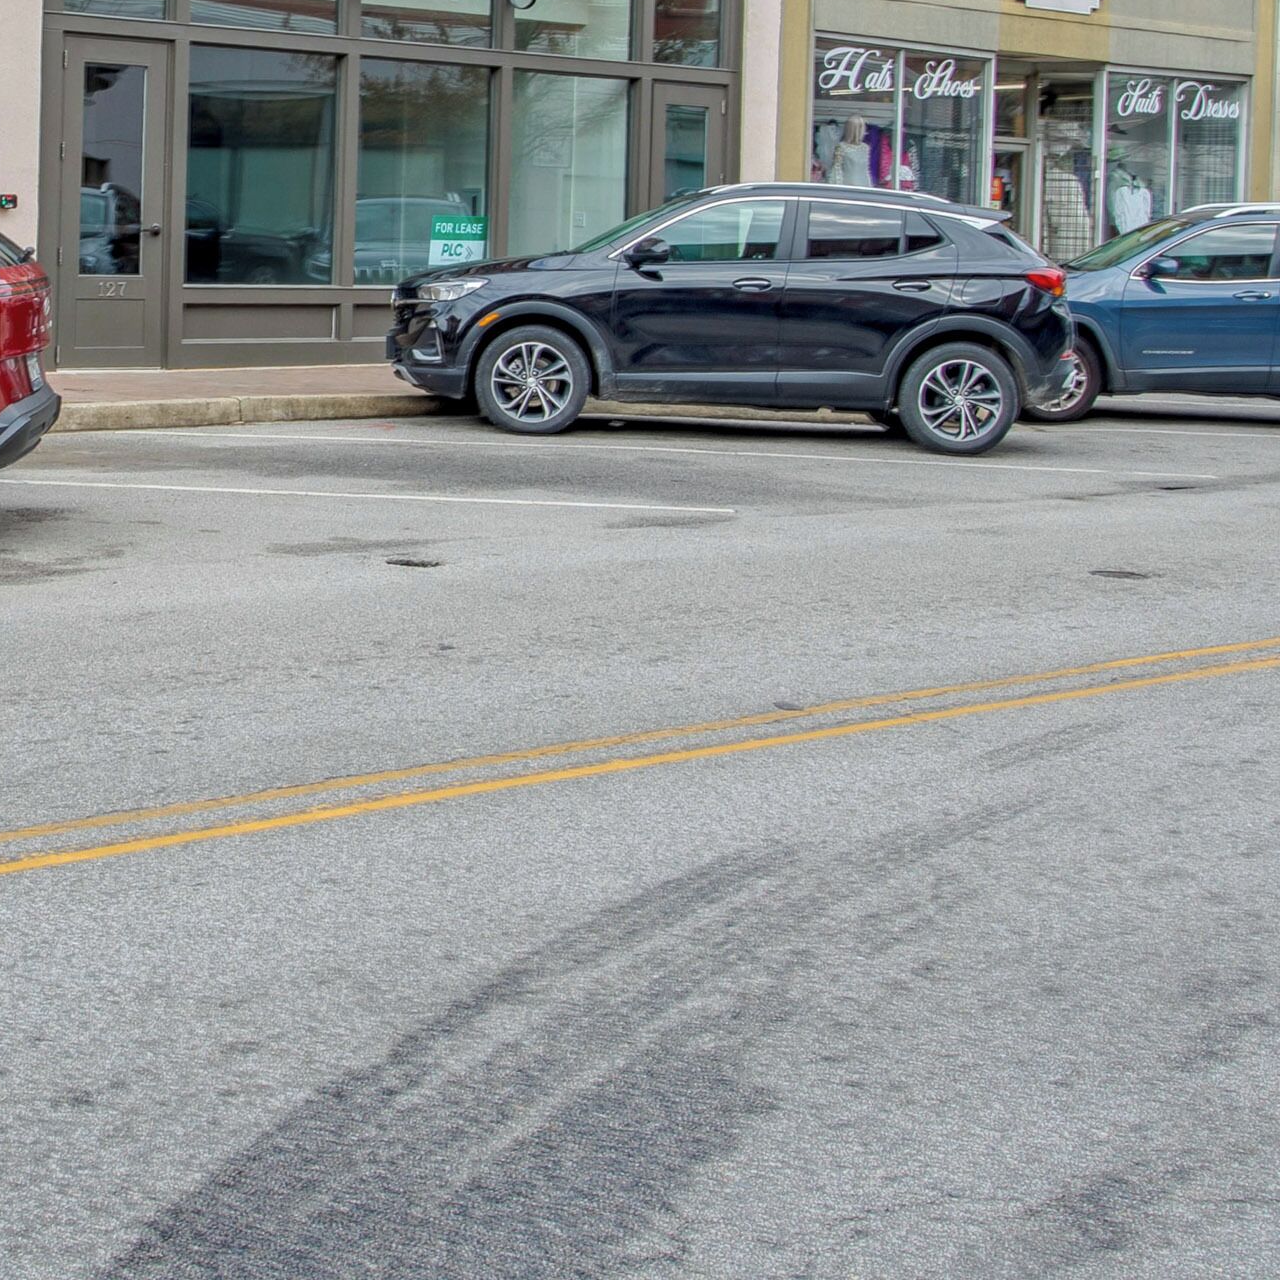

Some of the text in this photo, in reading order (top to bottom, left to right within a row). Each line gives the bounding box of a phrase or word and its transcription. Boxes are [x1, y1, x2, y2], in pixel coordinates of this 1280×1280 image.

[819, 47, 977, 100] Hats Shoes
[1118, 79, 1240, 120] Suits Dresses
[435, 222, 484, 234] FOR LEASE
[440, 243, 464, 257] PLC
[98, 281, 128, 297] 127
